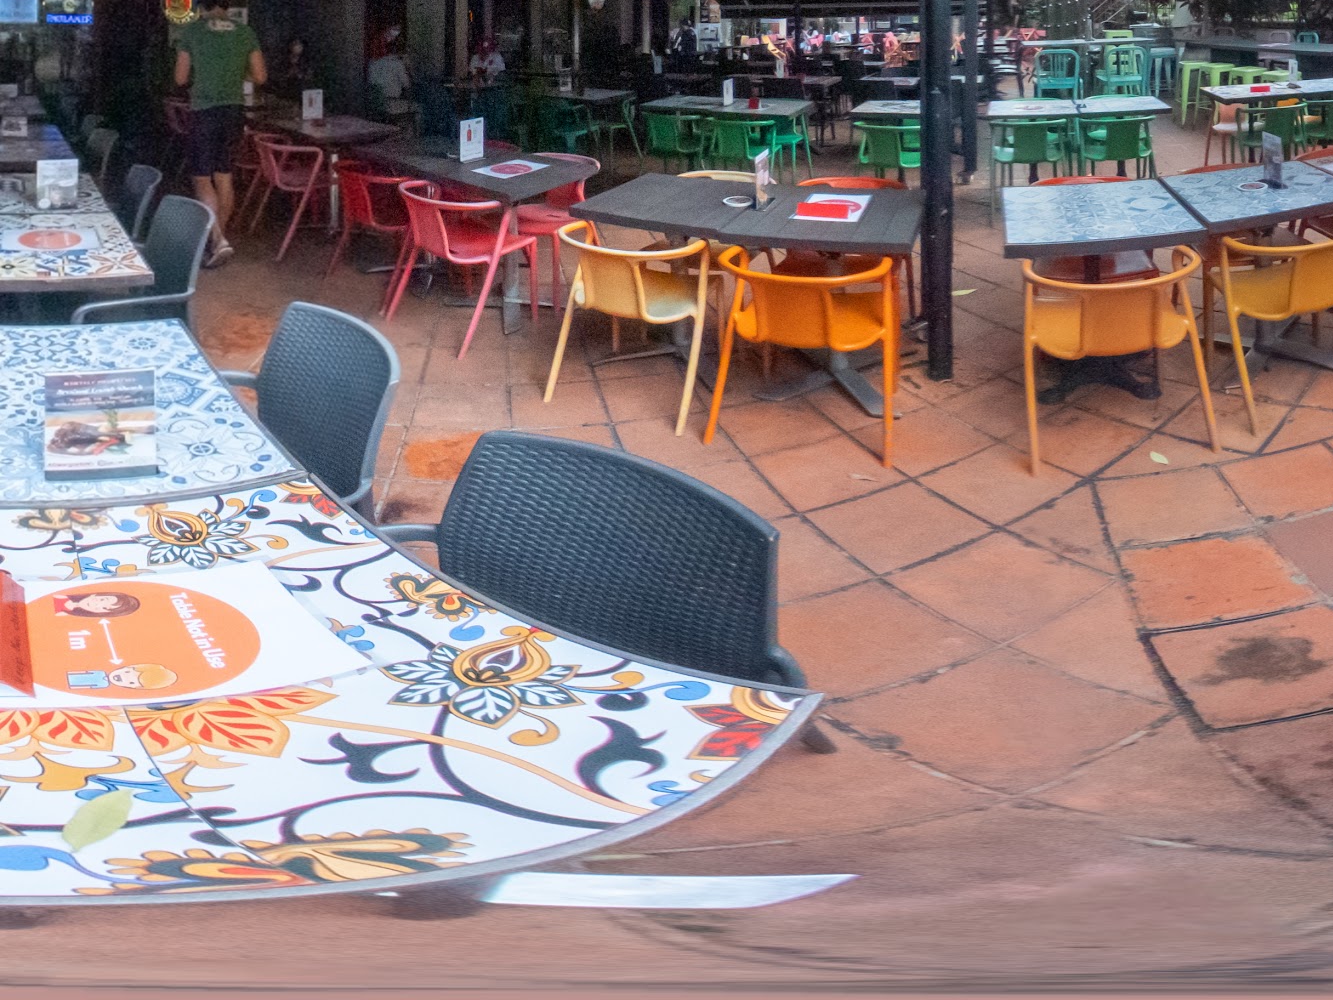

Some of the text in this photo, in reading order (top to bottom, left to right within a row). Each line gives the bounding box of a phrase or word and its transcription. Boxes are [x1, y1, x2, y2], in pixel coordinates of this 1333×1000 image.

[169, 592, 225, 668] Table Not in Use
